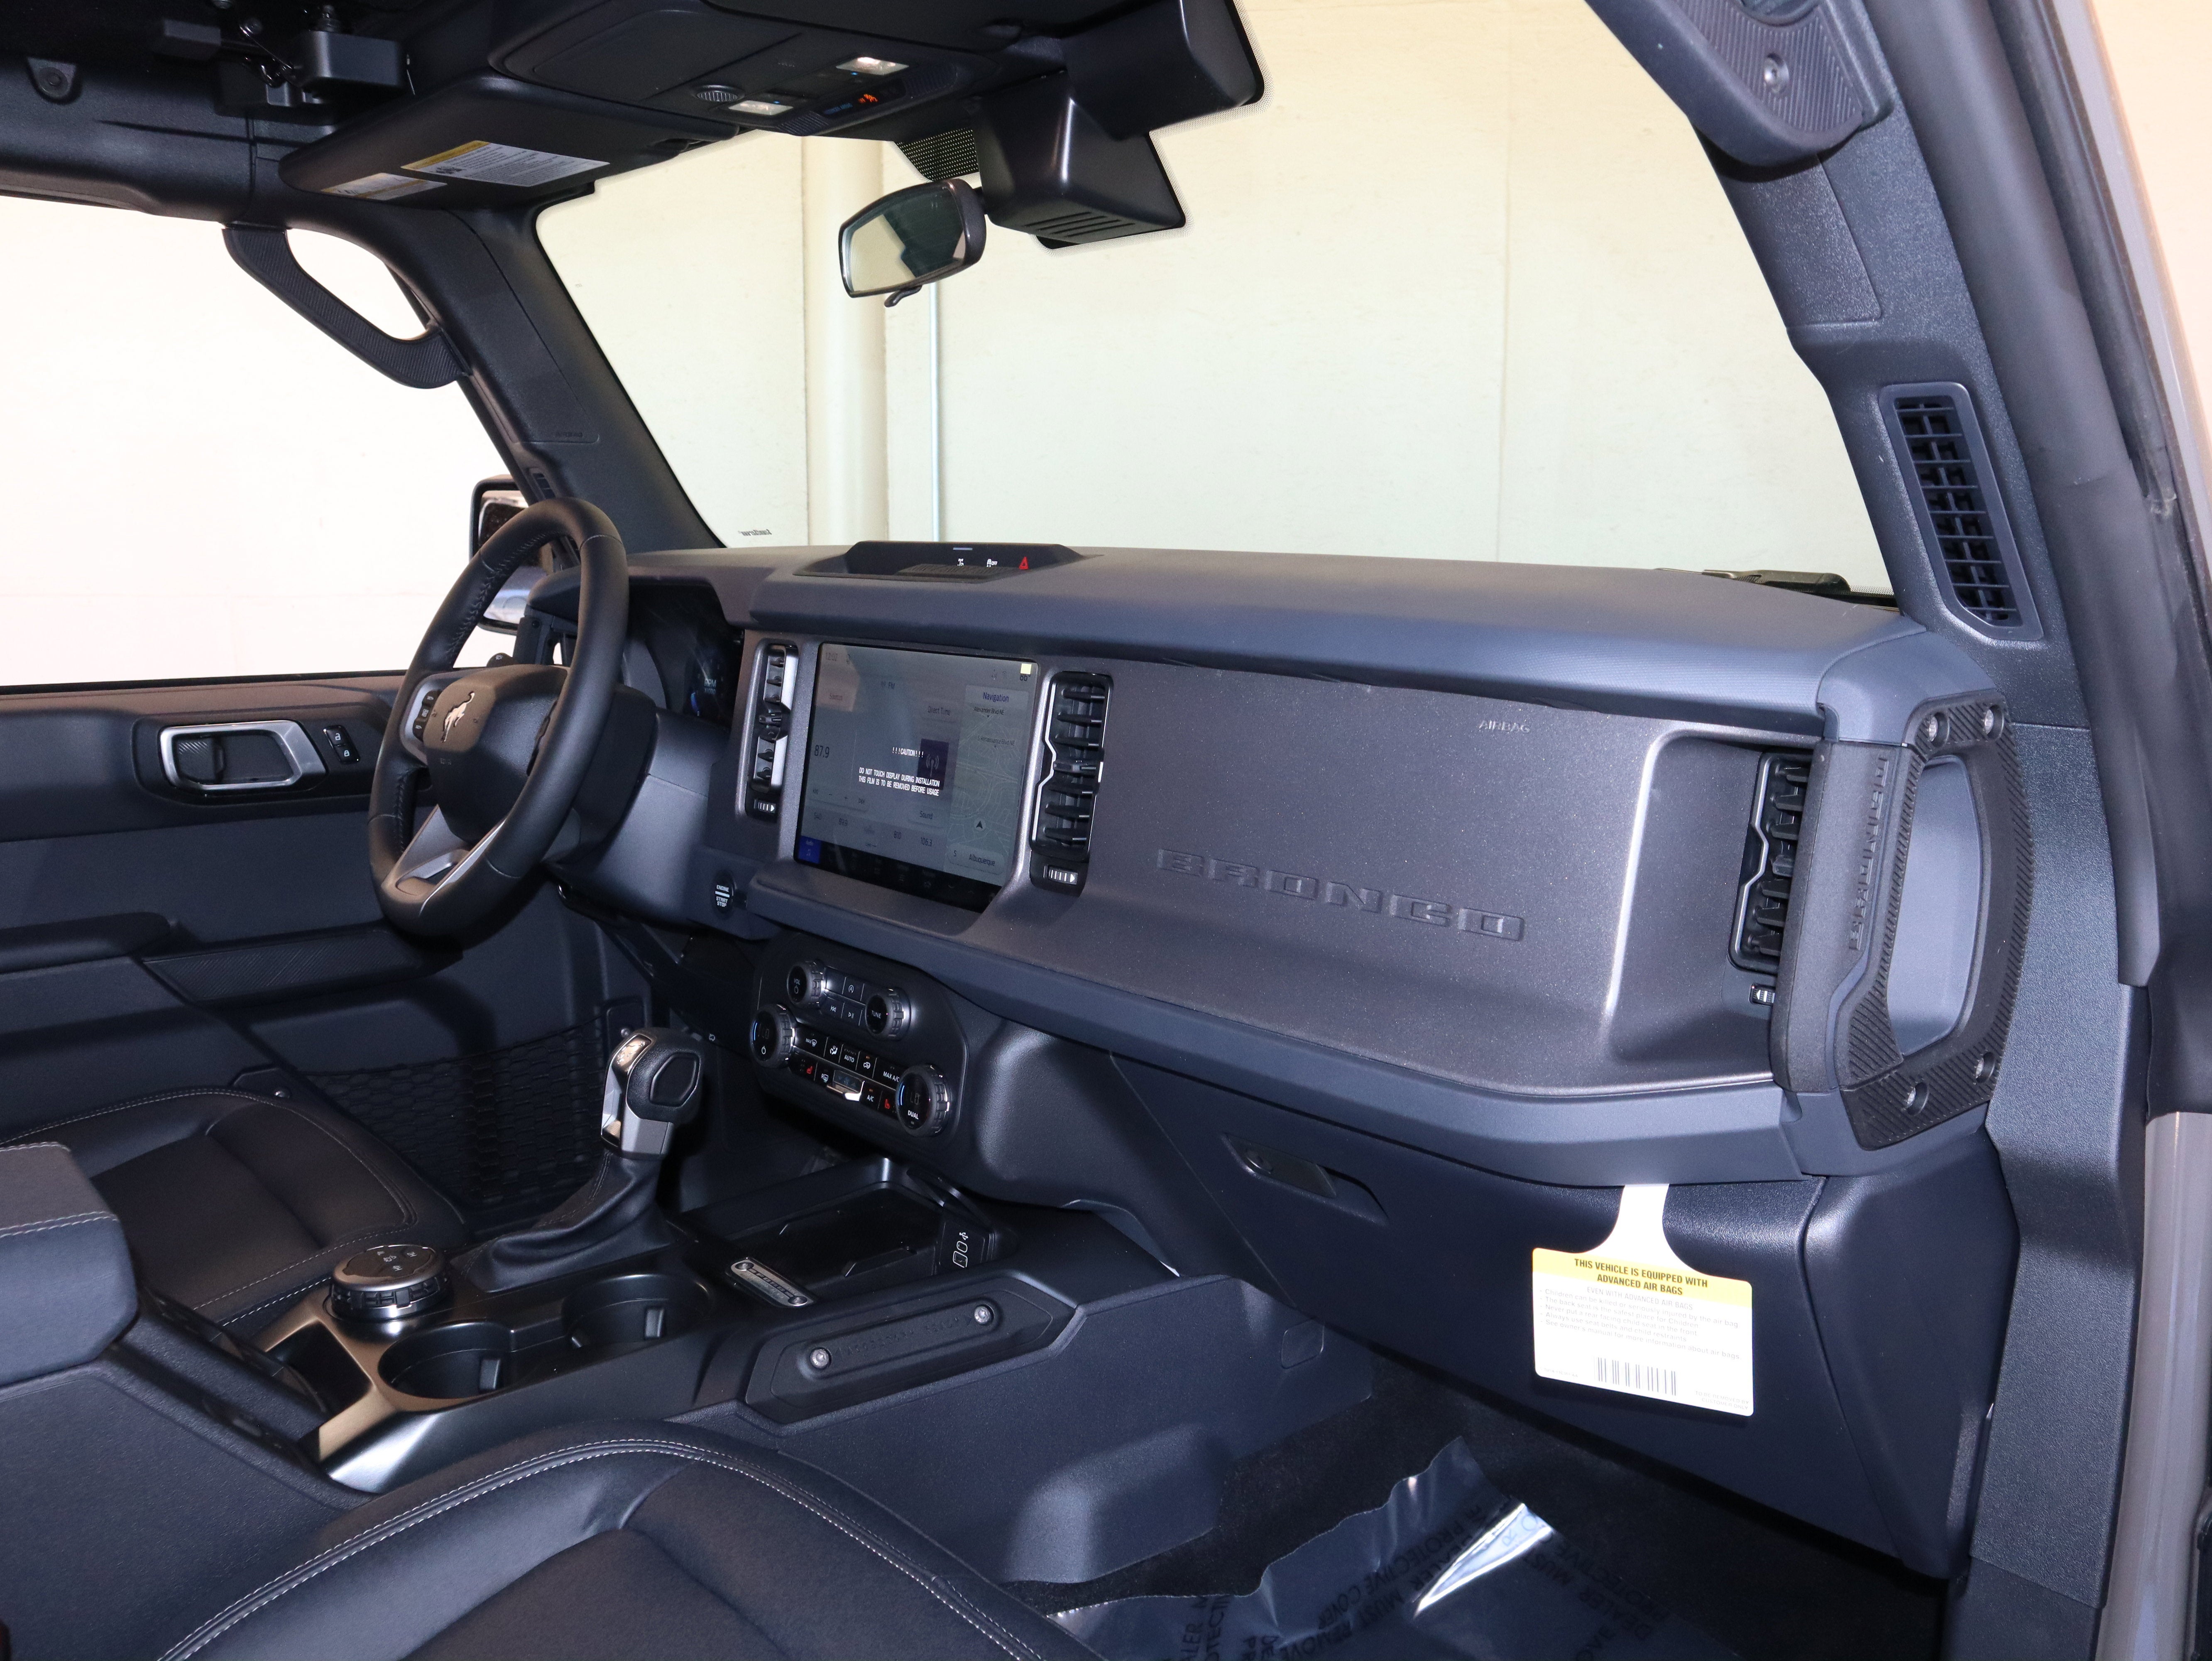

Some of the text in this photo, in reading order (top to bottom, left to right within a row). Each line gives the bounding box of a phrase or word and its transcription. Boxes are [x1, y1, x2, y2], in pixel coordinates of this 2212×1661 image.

[983, 692, 1009, 703] Navigation
[974, 706, 991, 714] Alexander
[1479, 720, 1530, 733] AIRBAG
[814, 744, 830, 759] 87.9
[886, 771, 900, 780] DISPLAY
[901, 774, 914, 783] DURING
[915, 777, 940, 787] INSTALLATION
[893, 782, 910, 791] REMOVED
[911, 785, 926, 794] BEFORE
[920, 810, 933, 820] Sound
[920, 837, 932, 847] 106.3
[1849, 755, 1889, 951] BRONCO
[969, 854, 996, 867] Albuquerque
[1157, 848, 1525, 941] BRONCO
[872, 1010, 881, 1019] TUNE
[844, 1054, 854, 1063] AUTO
[883, 1071, 892, 1080] MAX
[908, 1110, 919, 1120] DUAL
[1574, 1258, 1708, 1288] THIS VEHICLE IS EQUIPPED WITH
[1597, 1274, 1683, 1295] ADVANCED AIR BAGS
[1545, 1289, 1573, 1298] Children
[1599, 1298, 1617, 1307] killed
[1628, 1304, 1660, 1315] seriously
[1662, 1309, 1687, 1319] injured
[1587, 1286, 1603, 1295] EVEN
[1606, 1289, 1622, 1298] WITH
[1625, 1293, 1659, 1305] ADVANCED
[1675, 1302, 1693, 1310] BAGS
[1600, 1314, 1621, 1324] facing
[1623, 1318, 1640, 1326] child
[1614, 1309, 1634, 1317] safest
[1636, 1312, 1654, 1320] place
[1546, 1312, 1569, 1322] Always
[1635, 1328, 1651, 1336] child
[1588, 1328, 1613, 1337] manual
[1646, 1338, 1686, 1350] information
[1688, 1345, 1708, 1354] about
[1702, 1398, 1732, 1407] CUSTOMER
[1713, 1394, 1740, 1403] REMOVED
[1364, 1521, 1466, 1596] PROTECTIVE
[1523, 1553, 1653, 1641] DEALER MUST
[1319, 1585, 1362, 1629] COVER
[1361, 1590, 1405, 1628] MUST
